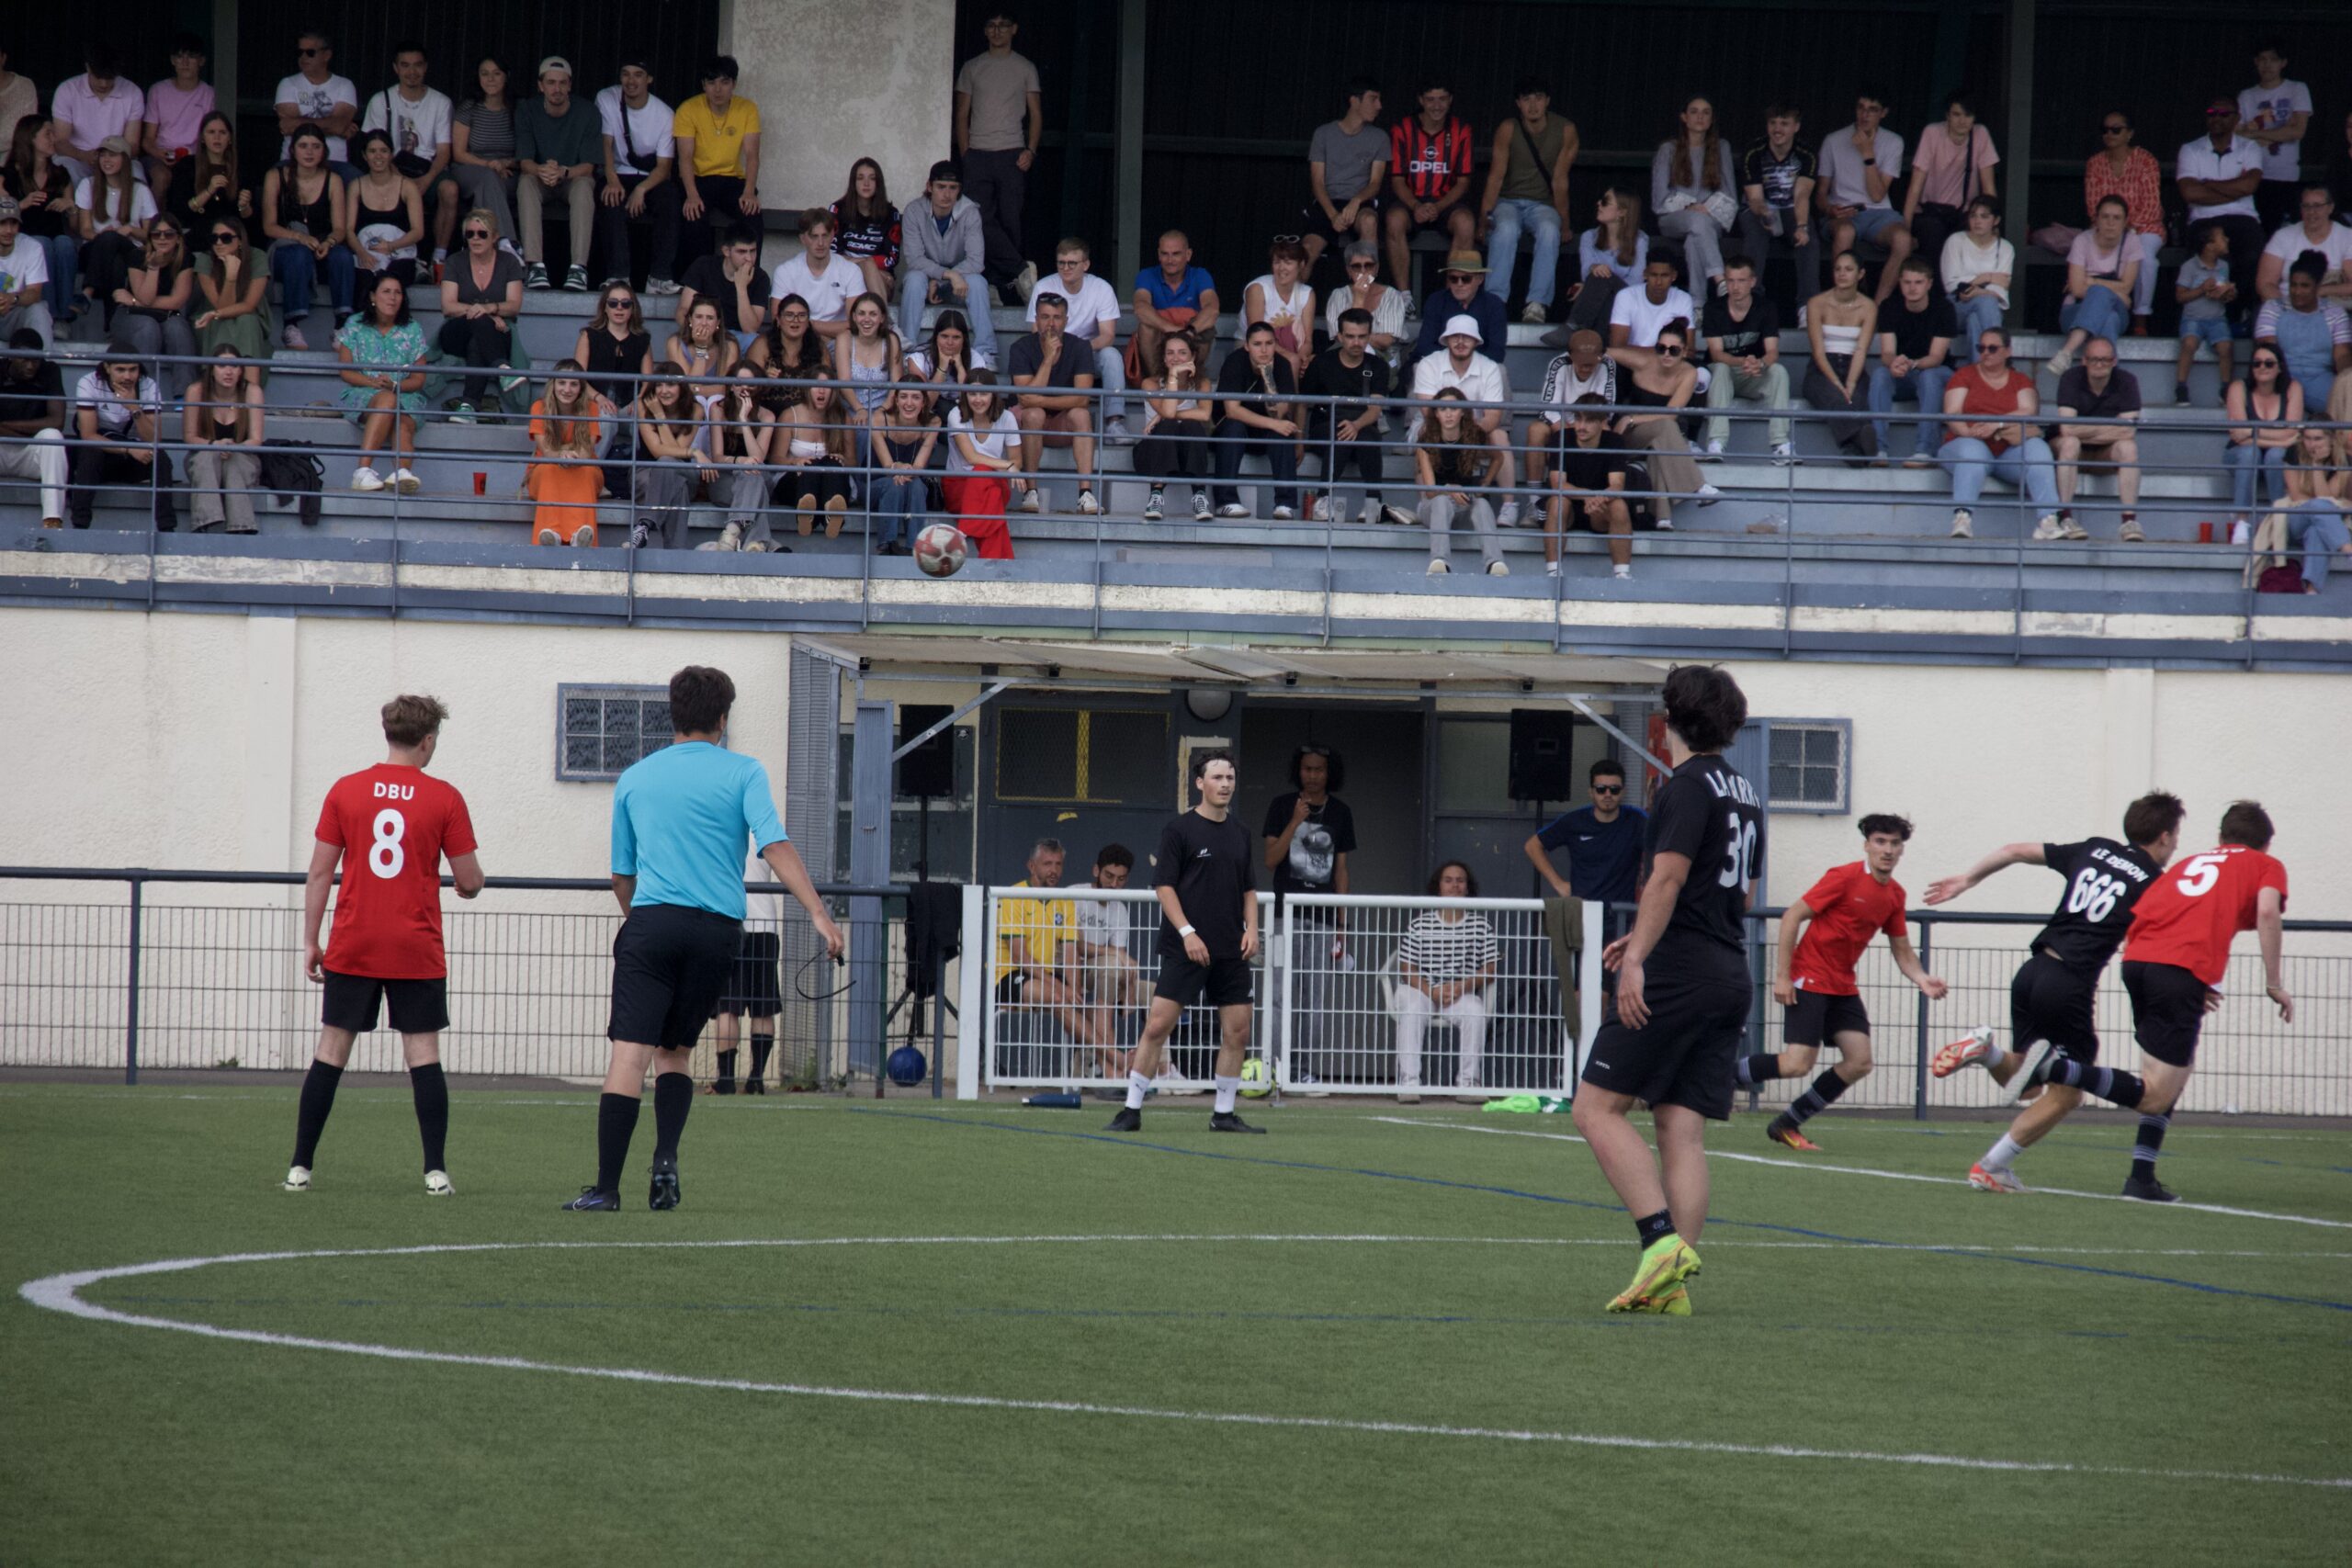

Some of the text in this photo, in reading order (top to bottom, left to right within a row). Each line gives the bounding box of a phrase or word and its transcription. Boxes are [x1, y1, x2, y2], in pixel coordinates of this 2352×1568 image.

[1409, 160, 1451, 174] OPEL
[843, 231, 884, 243] pure
[373, 782, 414, 801] DBU
[368, 807, 405, 879] 8
[1718, 812, 1757, 895] 30
[2090, 847, 2150, 883] LE DEMON
[2177, 854, 2228, 897] 5
[2068, 866, 2127, 923] 666
